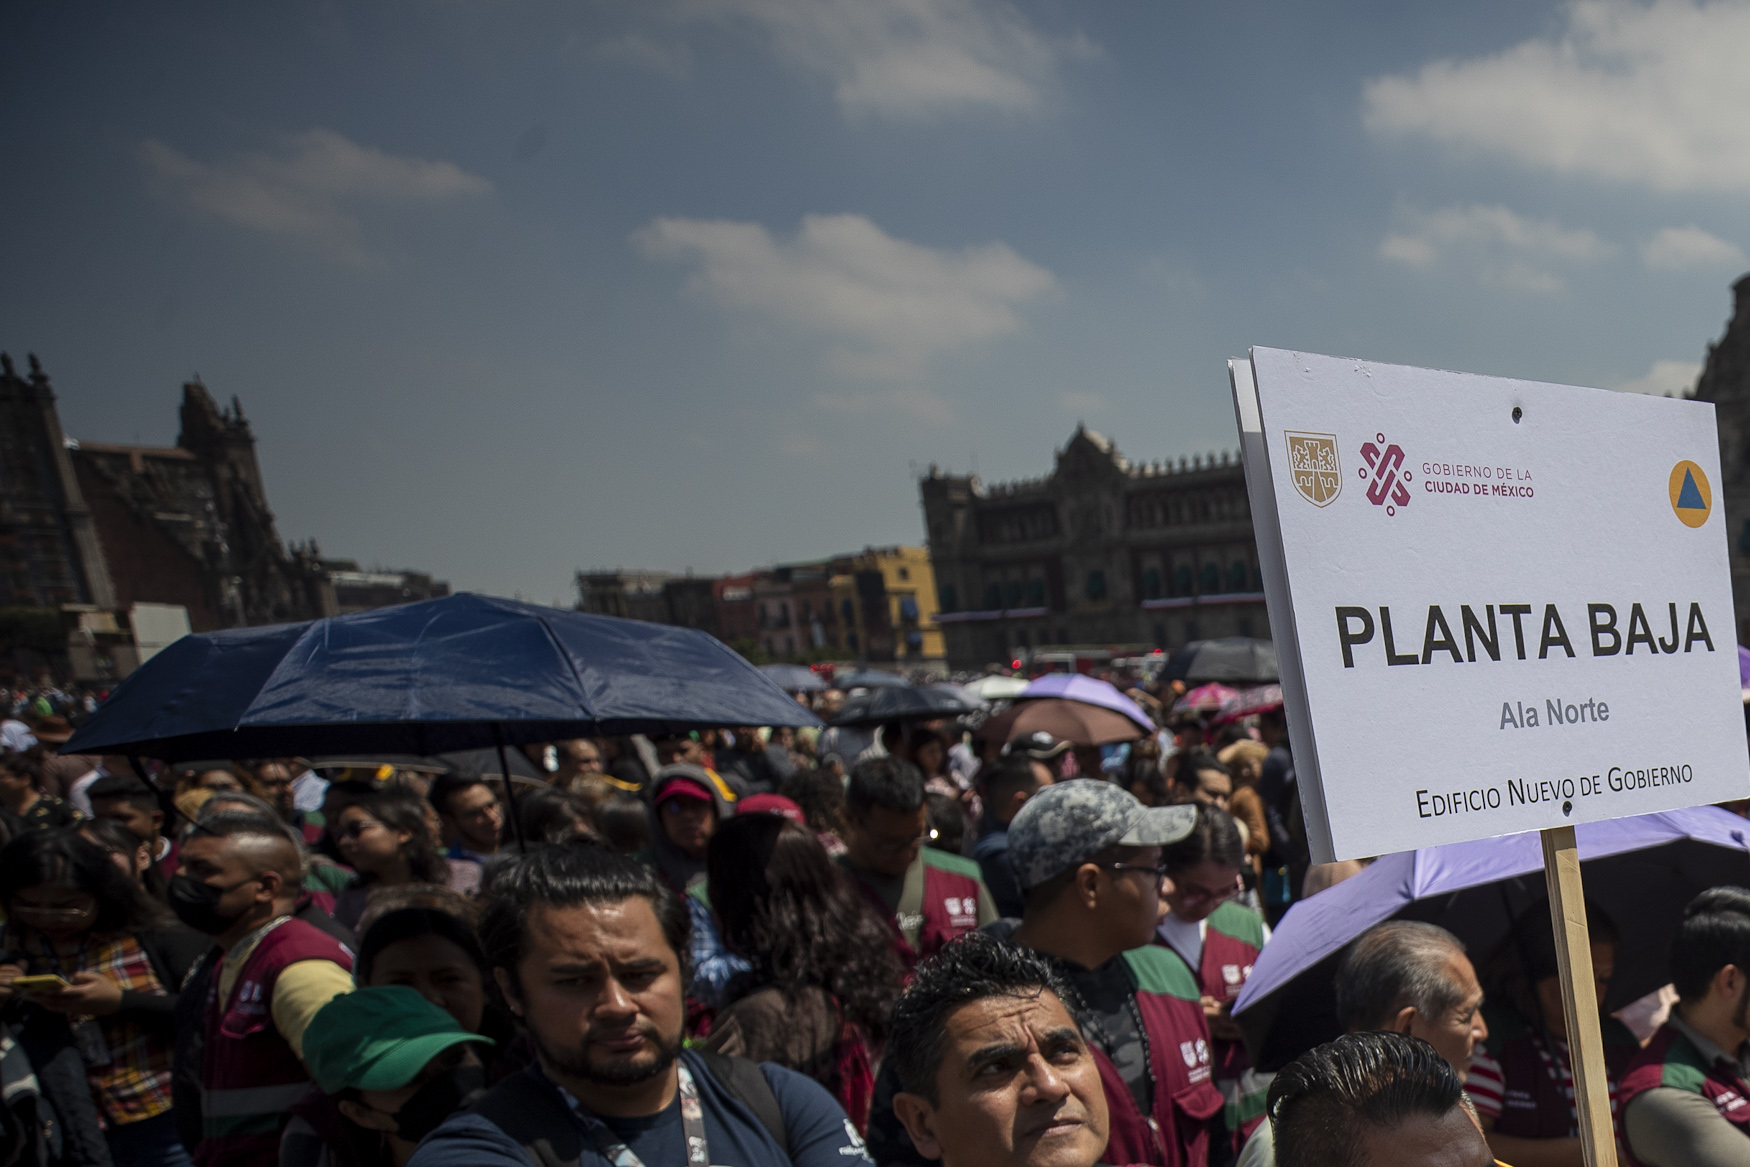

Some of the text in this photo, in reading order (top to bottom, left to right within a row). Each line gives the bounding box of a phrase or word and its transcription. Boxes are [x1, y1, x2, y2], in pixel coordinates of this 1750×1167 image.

[1422, 462, 1533, 481] GOBIERNO DE LA
[1424, 481, 1534, 498] CIUDAD DE MÉXICO
[1334, 602, 1715, 669] PLANTA BAJA
[1500, 696, 1610, 730] Ala Norte
